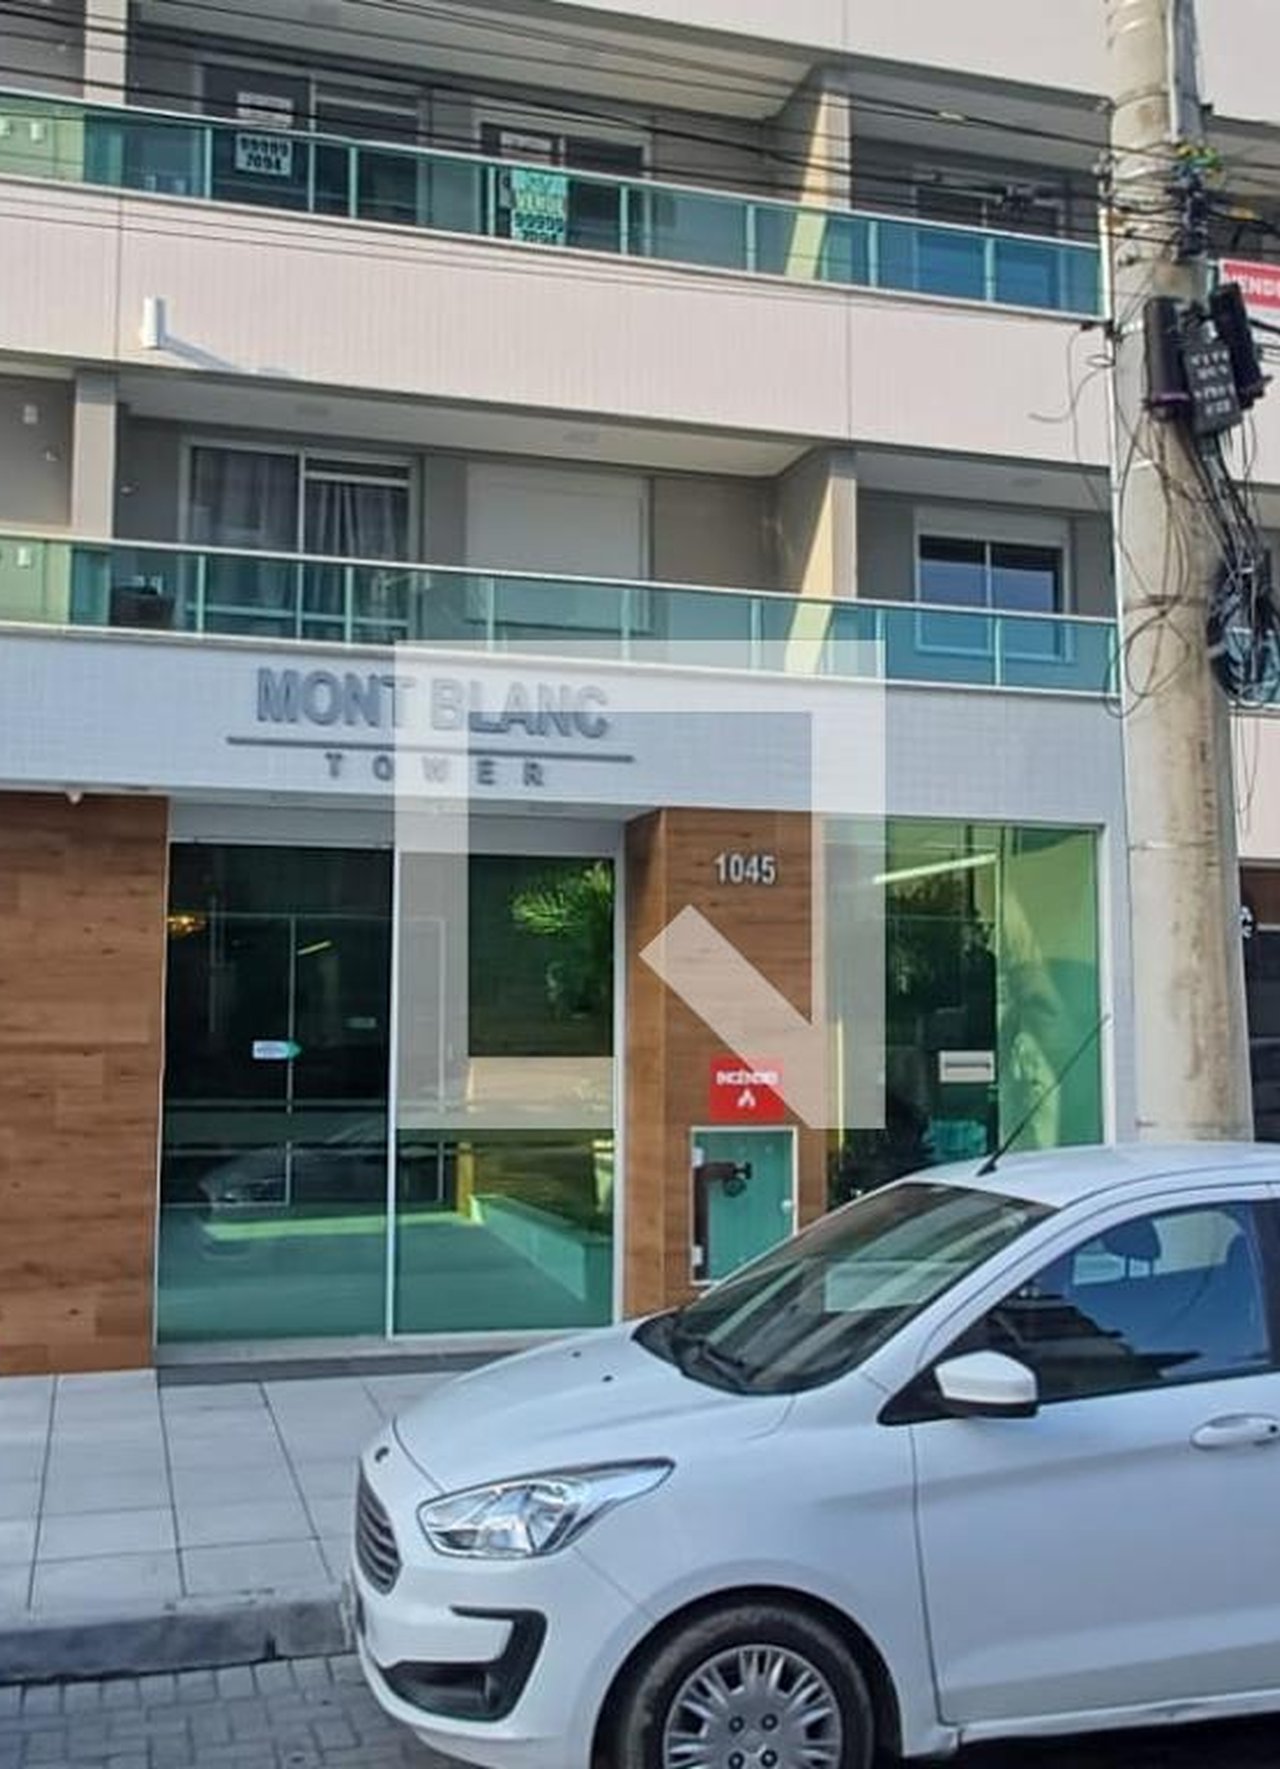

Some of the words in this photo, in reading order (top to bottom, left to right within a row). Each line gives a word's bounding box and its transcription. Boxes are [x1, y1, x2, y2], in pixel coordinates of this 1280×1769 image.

[256, 668, 416, 728] MONT
[430, 676, 611, 740] BLANC
[324, 751, 545, 787] TOWER
[713, 852, 776, 885] 1045
